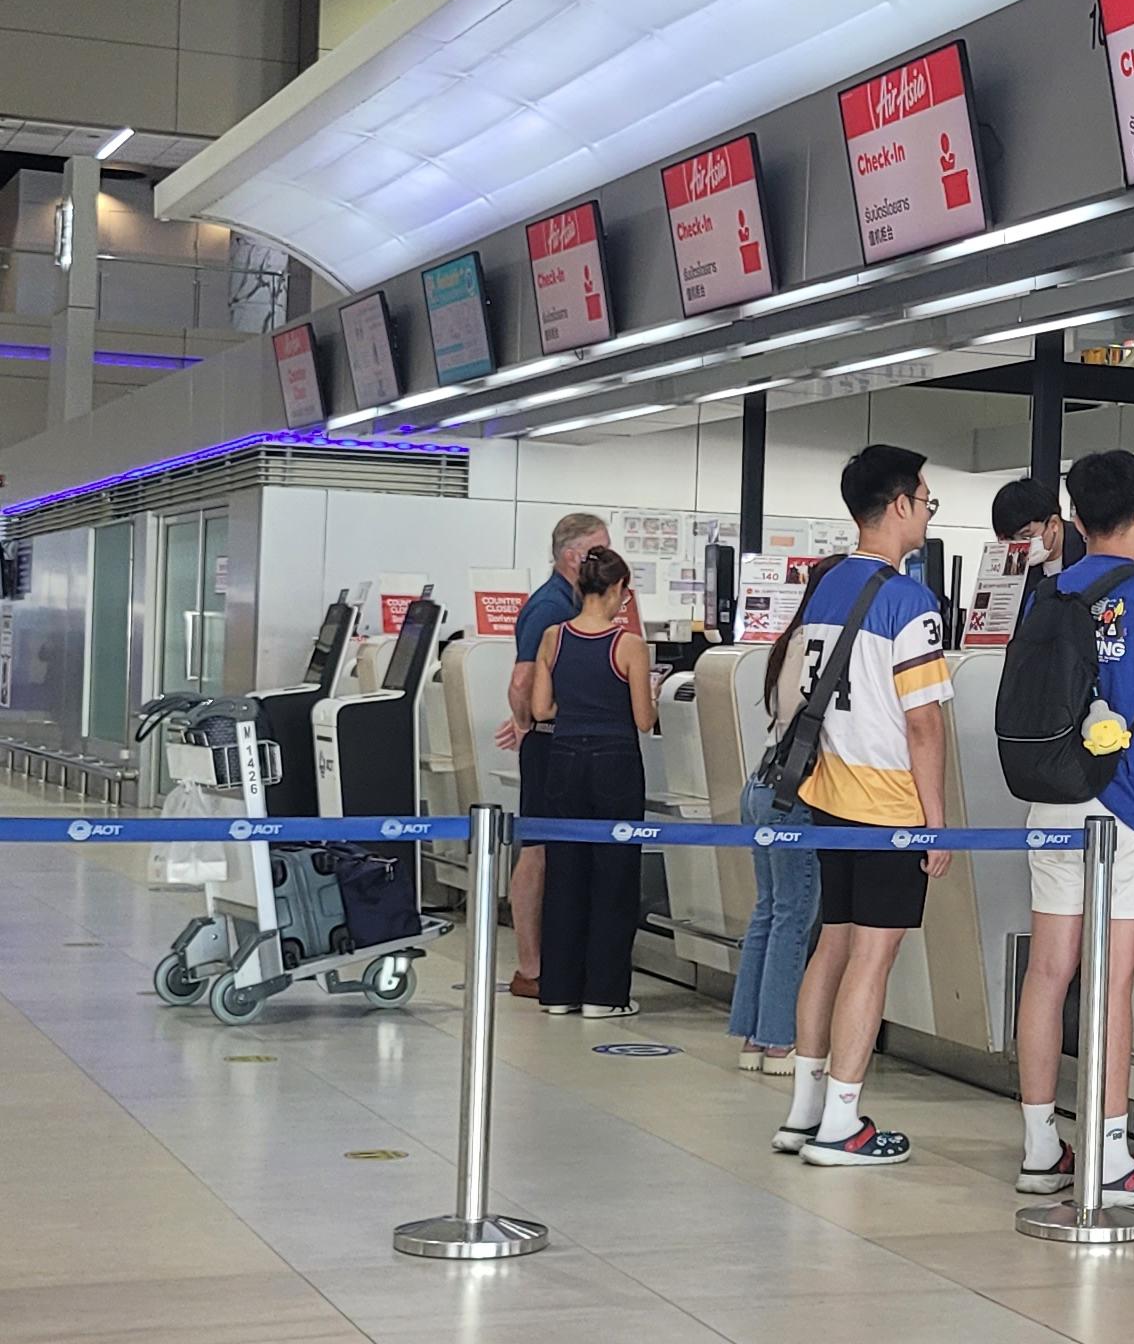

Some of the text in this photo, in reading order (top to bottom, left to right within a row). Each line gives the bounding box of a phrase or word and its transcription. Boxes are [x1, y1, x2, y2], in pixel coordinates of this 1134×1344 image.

[857, 142, 906, 176] Check-In
[762, 572, 780, 581] 140
[91, 824, 123, 836] AOT
[252, 824, 283, 835] AOT
[402, 823, 432, 834] AOT
[631, 827, 662, 838] AOT
[774, 831, 802, 842] AOT
[911, 834, 938, 844] AOT
[1045, 834, 1072, 844] AOT
